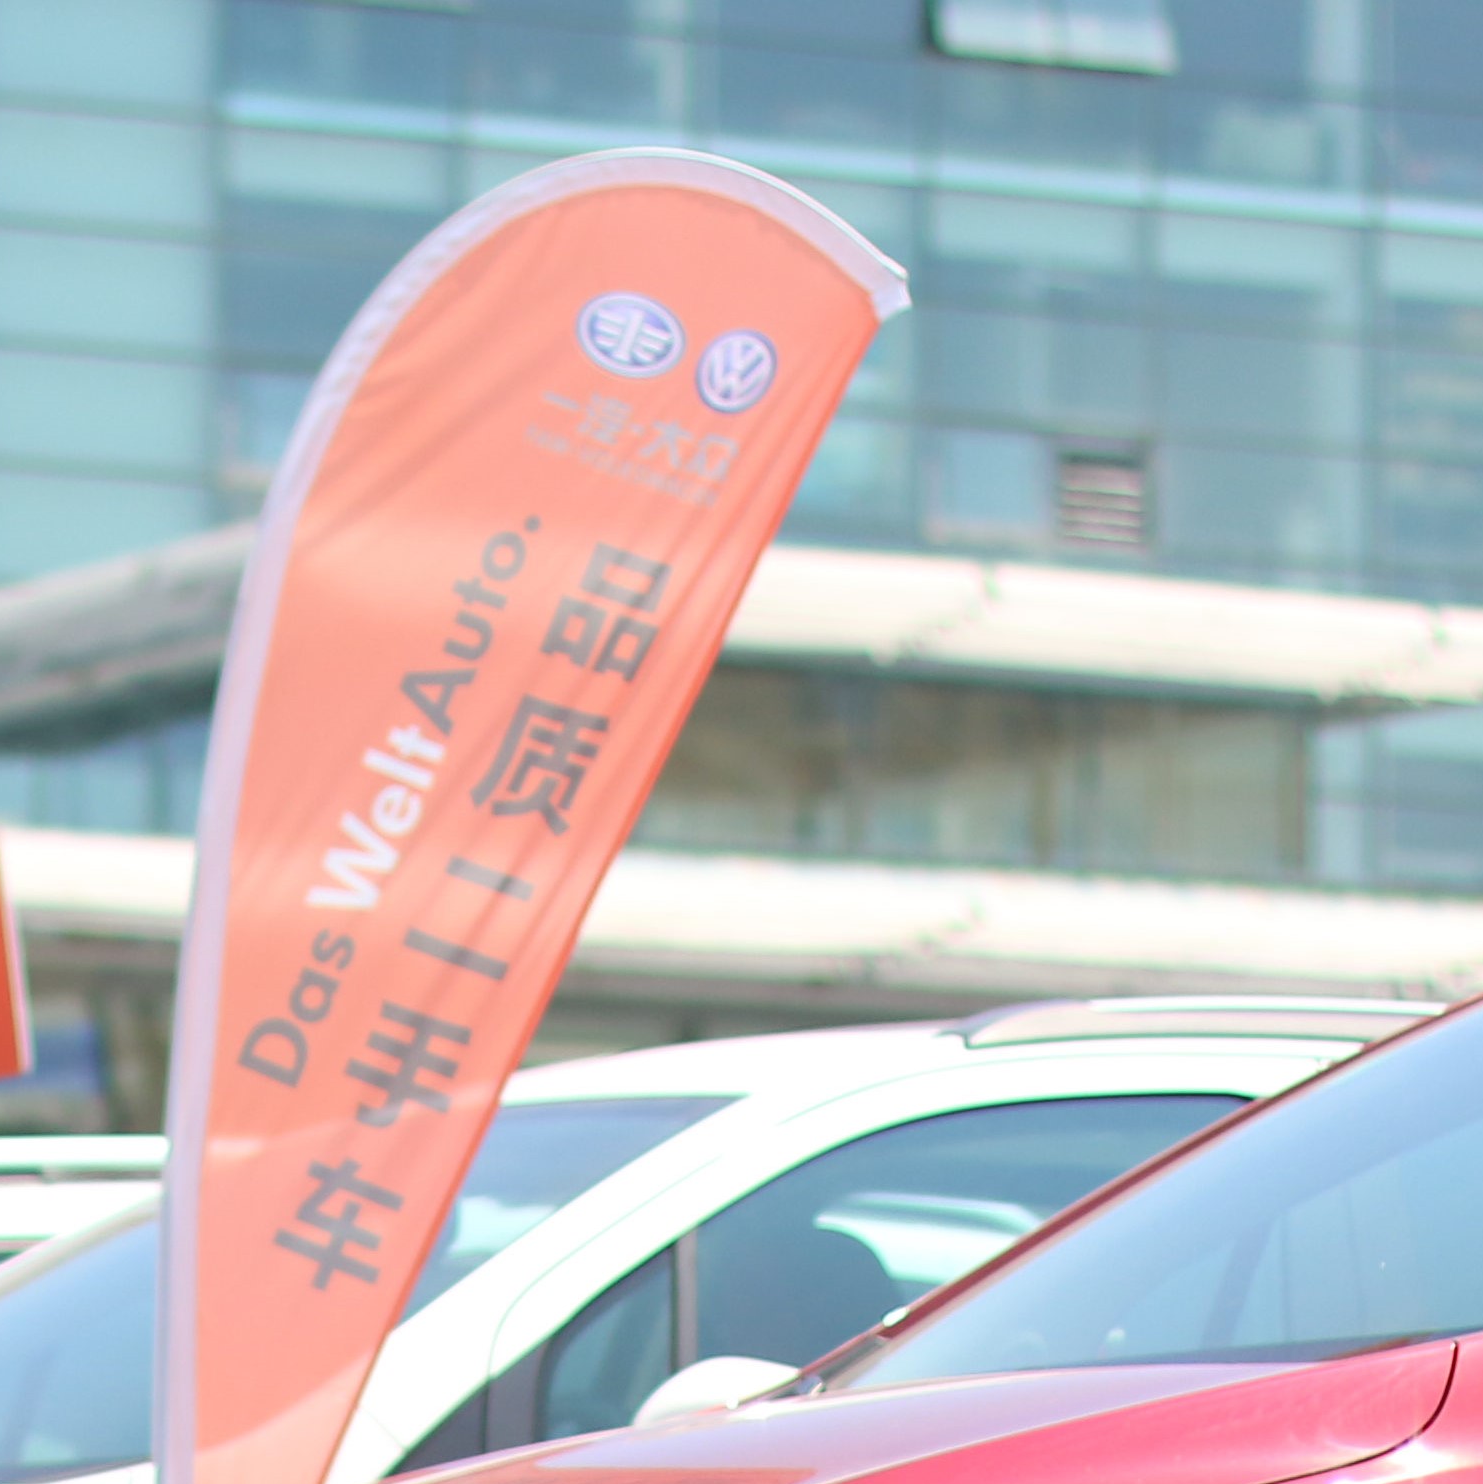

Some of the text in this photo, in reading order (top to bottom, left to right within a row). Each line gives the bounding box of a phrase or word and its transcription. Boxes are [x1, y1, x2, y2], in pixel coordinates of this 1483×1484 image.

[237, 928, 356, 1088] Das
[273, 542, 672, 1290] 品质二手车
